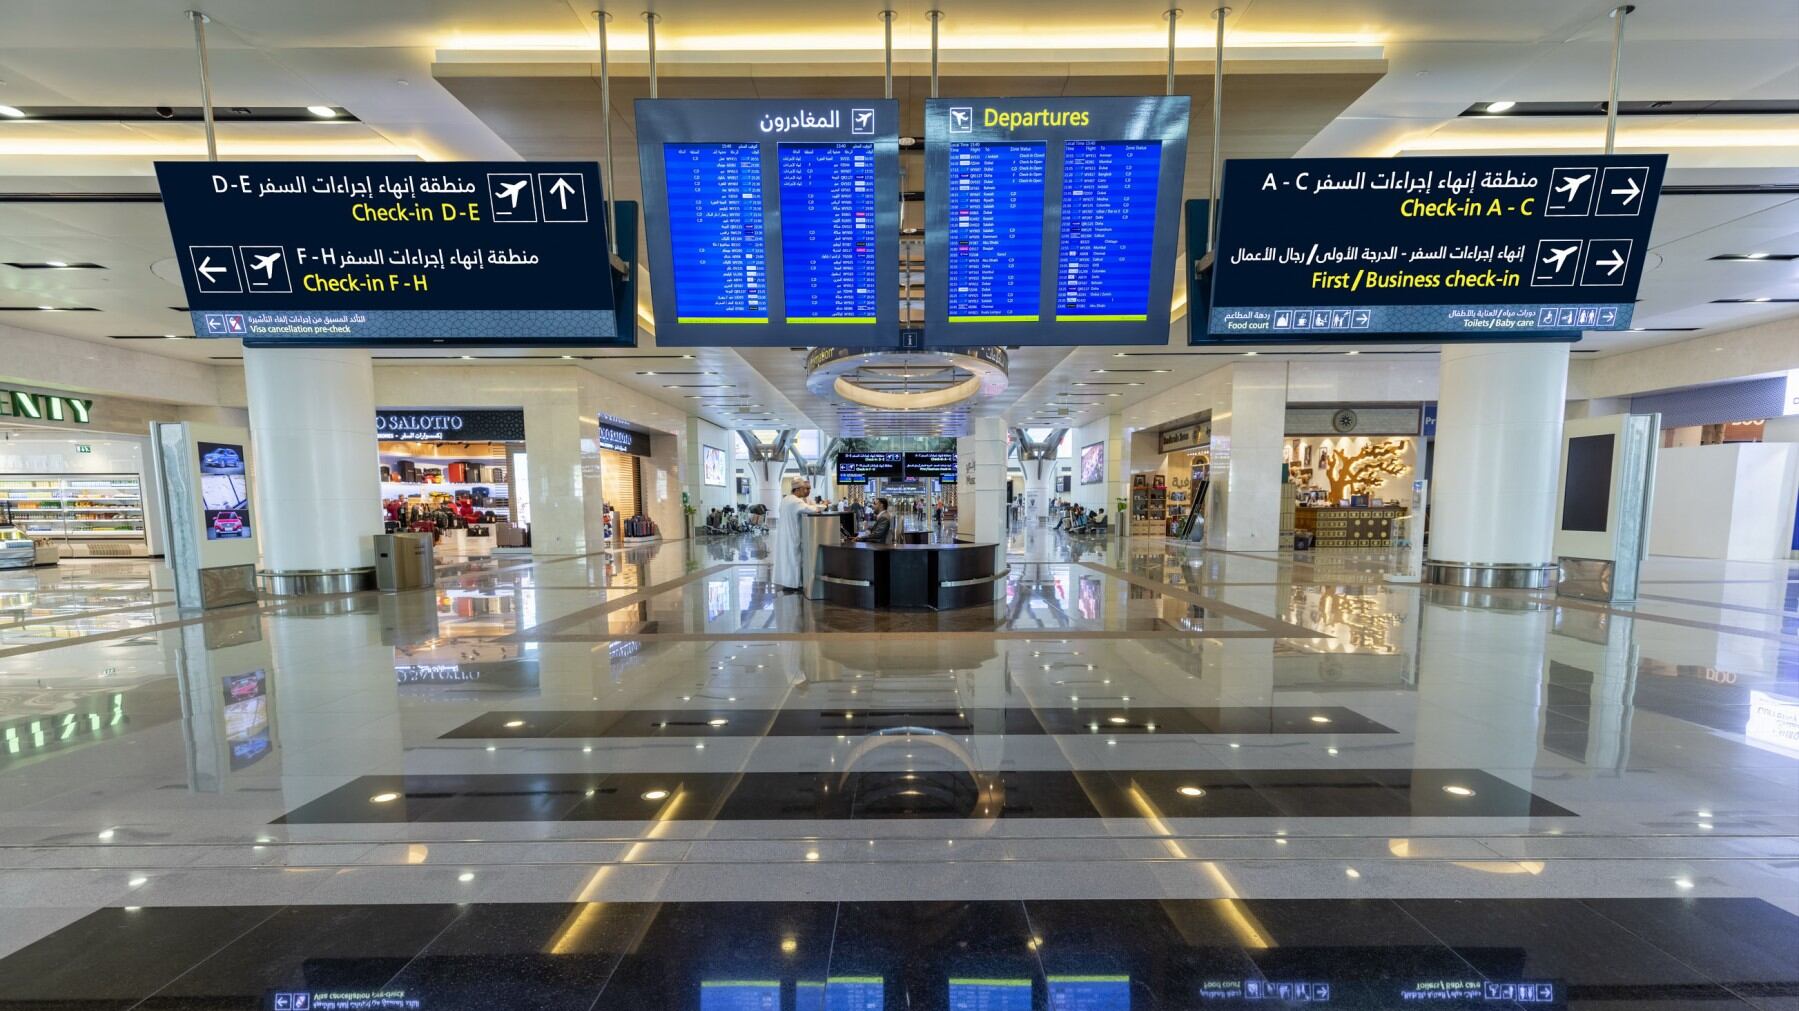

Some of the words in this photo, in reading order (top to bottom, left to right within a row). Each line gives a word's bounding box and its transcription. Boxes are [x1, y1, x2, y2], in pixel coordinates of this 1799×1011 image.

[760, 109, 840, 132] المغادرون
[984, 108, 1089, 131] Departures
[259, 175, 307, 197] السفر
[312, 175, 374, 200] إجراءات
[378, 175, 416, 200] إنهاء
[420, 175, 476, 193] منطقة
[1313, 172, 1366, 194] السفر
[1371, 170, 1433, 194] إجراءات
[1437, 170, 1476, 195] إنهاء
[1480, 170, 1538, 188] منطقة
[352, 202, 434, 222] Check-in
[1400, 198, 1482, 217] Check-in
[340, 248, 384, 268] السفر
[389, 248, 446, 270] إجراءات
[450, 248, 485, 270] إنهاء
[488, 248, 540, 265] منطقة
[1230, 247, 1276, 265] الأعمال
[1360, 246, 1398, 263] الدرجة
[1408, 246, 1446, 263] السفر
[1448, 245, 1494, 263] إجراءات
[1495, 245, 1525, 263] إنهاء
[303, 273, 384, 292] Check-in
[1444, 270, 1520, 288] check-in
[1224, 312, 1254, 322] المطاعم
[1228, 321, 1248, 330] Food
[250, 324, 265, 333] Visa
[266, 324, 312, 334] cancellation
[313, 324, 350, 335] pre-check
[389, 416, 462, 430] SALOTTO
